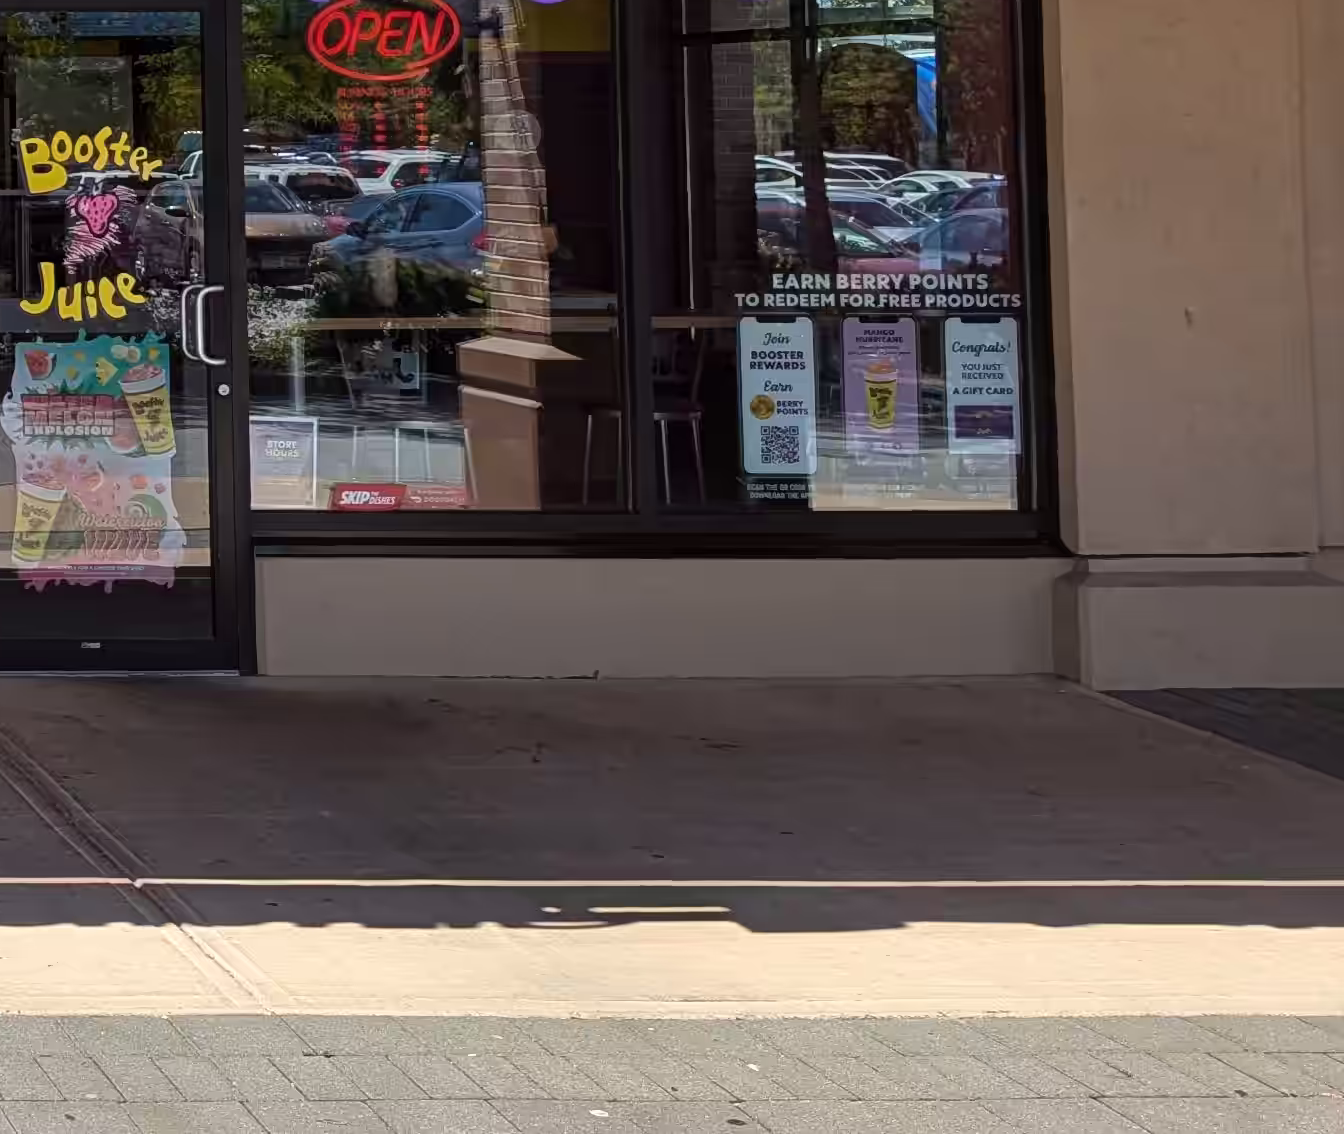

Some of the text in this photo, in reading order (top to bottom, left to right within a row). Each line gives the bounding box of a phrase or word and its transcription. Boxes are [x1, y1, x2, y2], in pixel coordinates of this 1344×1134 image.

[317, 10, 446, 57] OPEN
[20, 126, 162, 194] Booster
[772, 274, 989, 289] EARN BERRY POINTS
[19, 262, 147, 322] Juice
[734, 293, 1021, 307] TO REDEEM FOR FREE PRODUCTS
[763, 332, 790, 346] Join
[952, 340, 1011, 357] Congrats!
[751, 351, 804, 359] BOOSTER
[750, 361, 806, 370] REWARDS
[961, 372, 1004, 380] RECEIVED
[763, 380, 793, 392] Earn
[986, 387, 1013, 395] CARD
[24, 426, 114, 436] EXPLOSION
[267, 440, 297, 449] STORE
[264, 449, 300, 458] HOURS
[340, 491, 370, 504] SKIP
